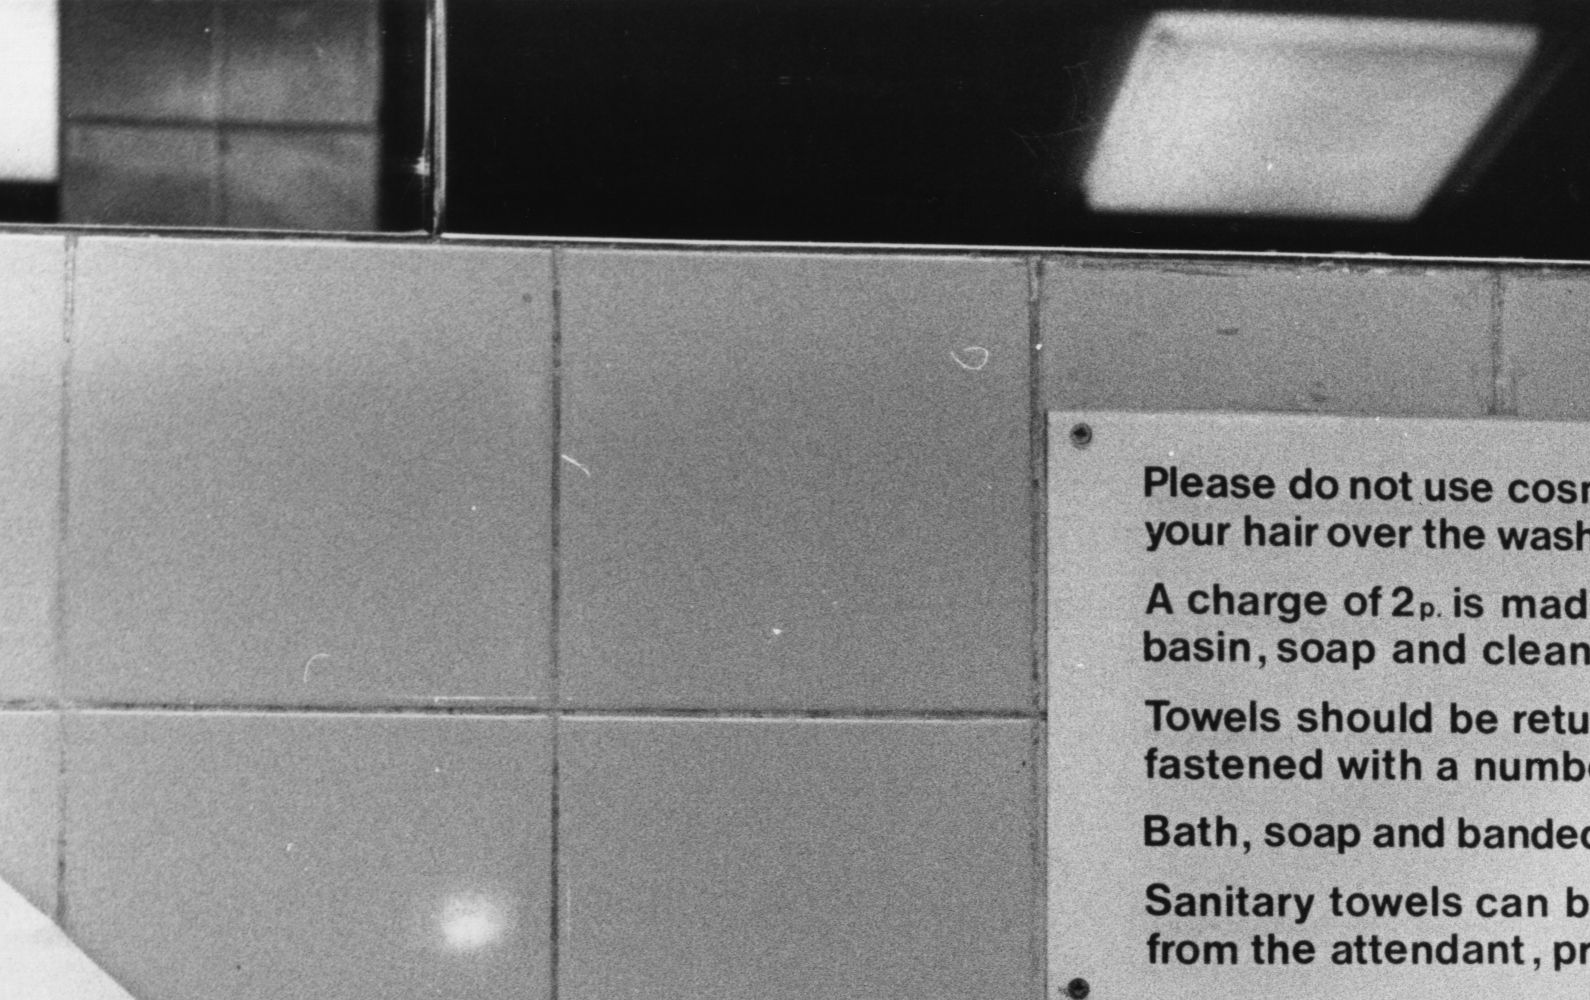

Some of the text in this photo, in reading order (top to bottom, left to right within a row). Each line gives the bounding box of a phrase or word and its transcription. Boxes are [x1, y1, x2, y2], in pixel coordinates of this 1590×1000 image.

[1144, 466, 1276, 500] Please
[1288, 468, 1340, 501] do
[1349, 472, 1413, 502] not
[1424, 478, 1494, 504] use
[1145, 521, 1231, 553] your
[1243, 515, 1319, 548] hair
[1326, 523, 1413, 549] over
[1422, 518, 1486, 550] the
[1145, 583, 1174, 615] A
[1187, 584, 1328, 625] charge
[1343, 586, 1382, 617] of
[1453, 587, 1484, 619] is
[1143, 631, 1267, 668] basin,
[1277, 638, 1376, 671] soap
[1392, 633, 1466, 665] and
[1482, 635, 1590, 666] clean
[1145, 700, 1281, 734] Towels
[1297, 701, 1433, 734] should
[1450, 703, 1498, 735] be
[1144, 747, 1323, 781] fastened
[1337, 749, 1422, 781] with
[1436, 757, 1458, 782] a
[1143, 815, 1251, 853] Bath,
[1264, 822, 1361, 855] soap
[1372, 817, 1445, 849] and
[1145, 883, 1315, 925] Sanitary
[1329, 886, 1463, 918] towels
[1476, 893, 1548, 918] can
[1146, 932, 1238, 965] from
[1251, 933, 1316, 965] the
[1331, 934, 1542, 972] attendant,
